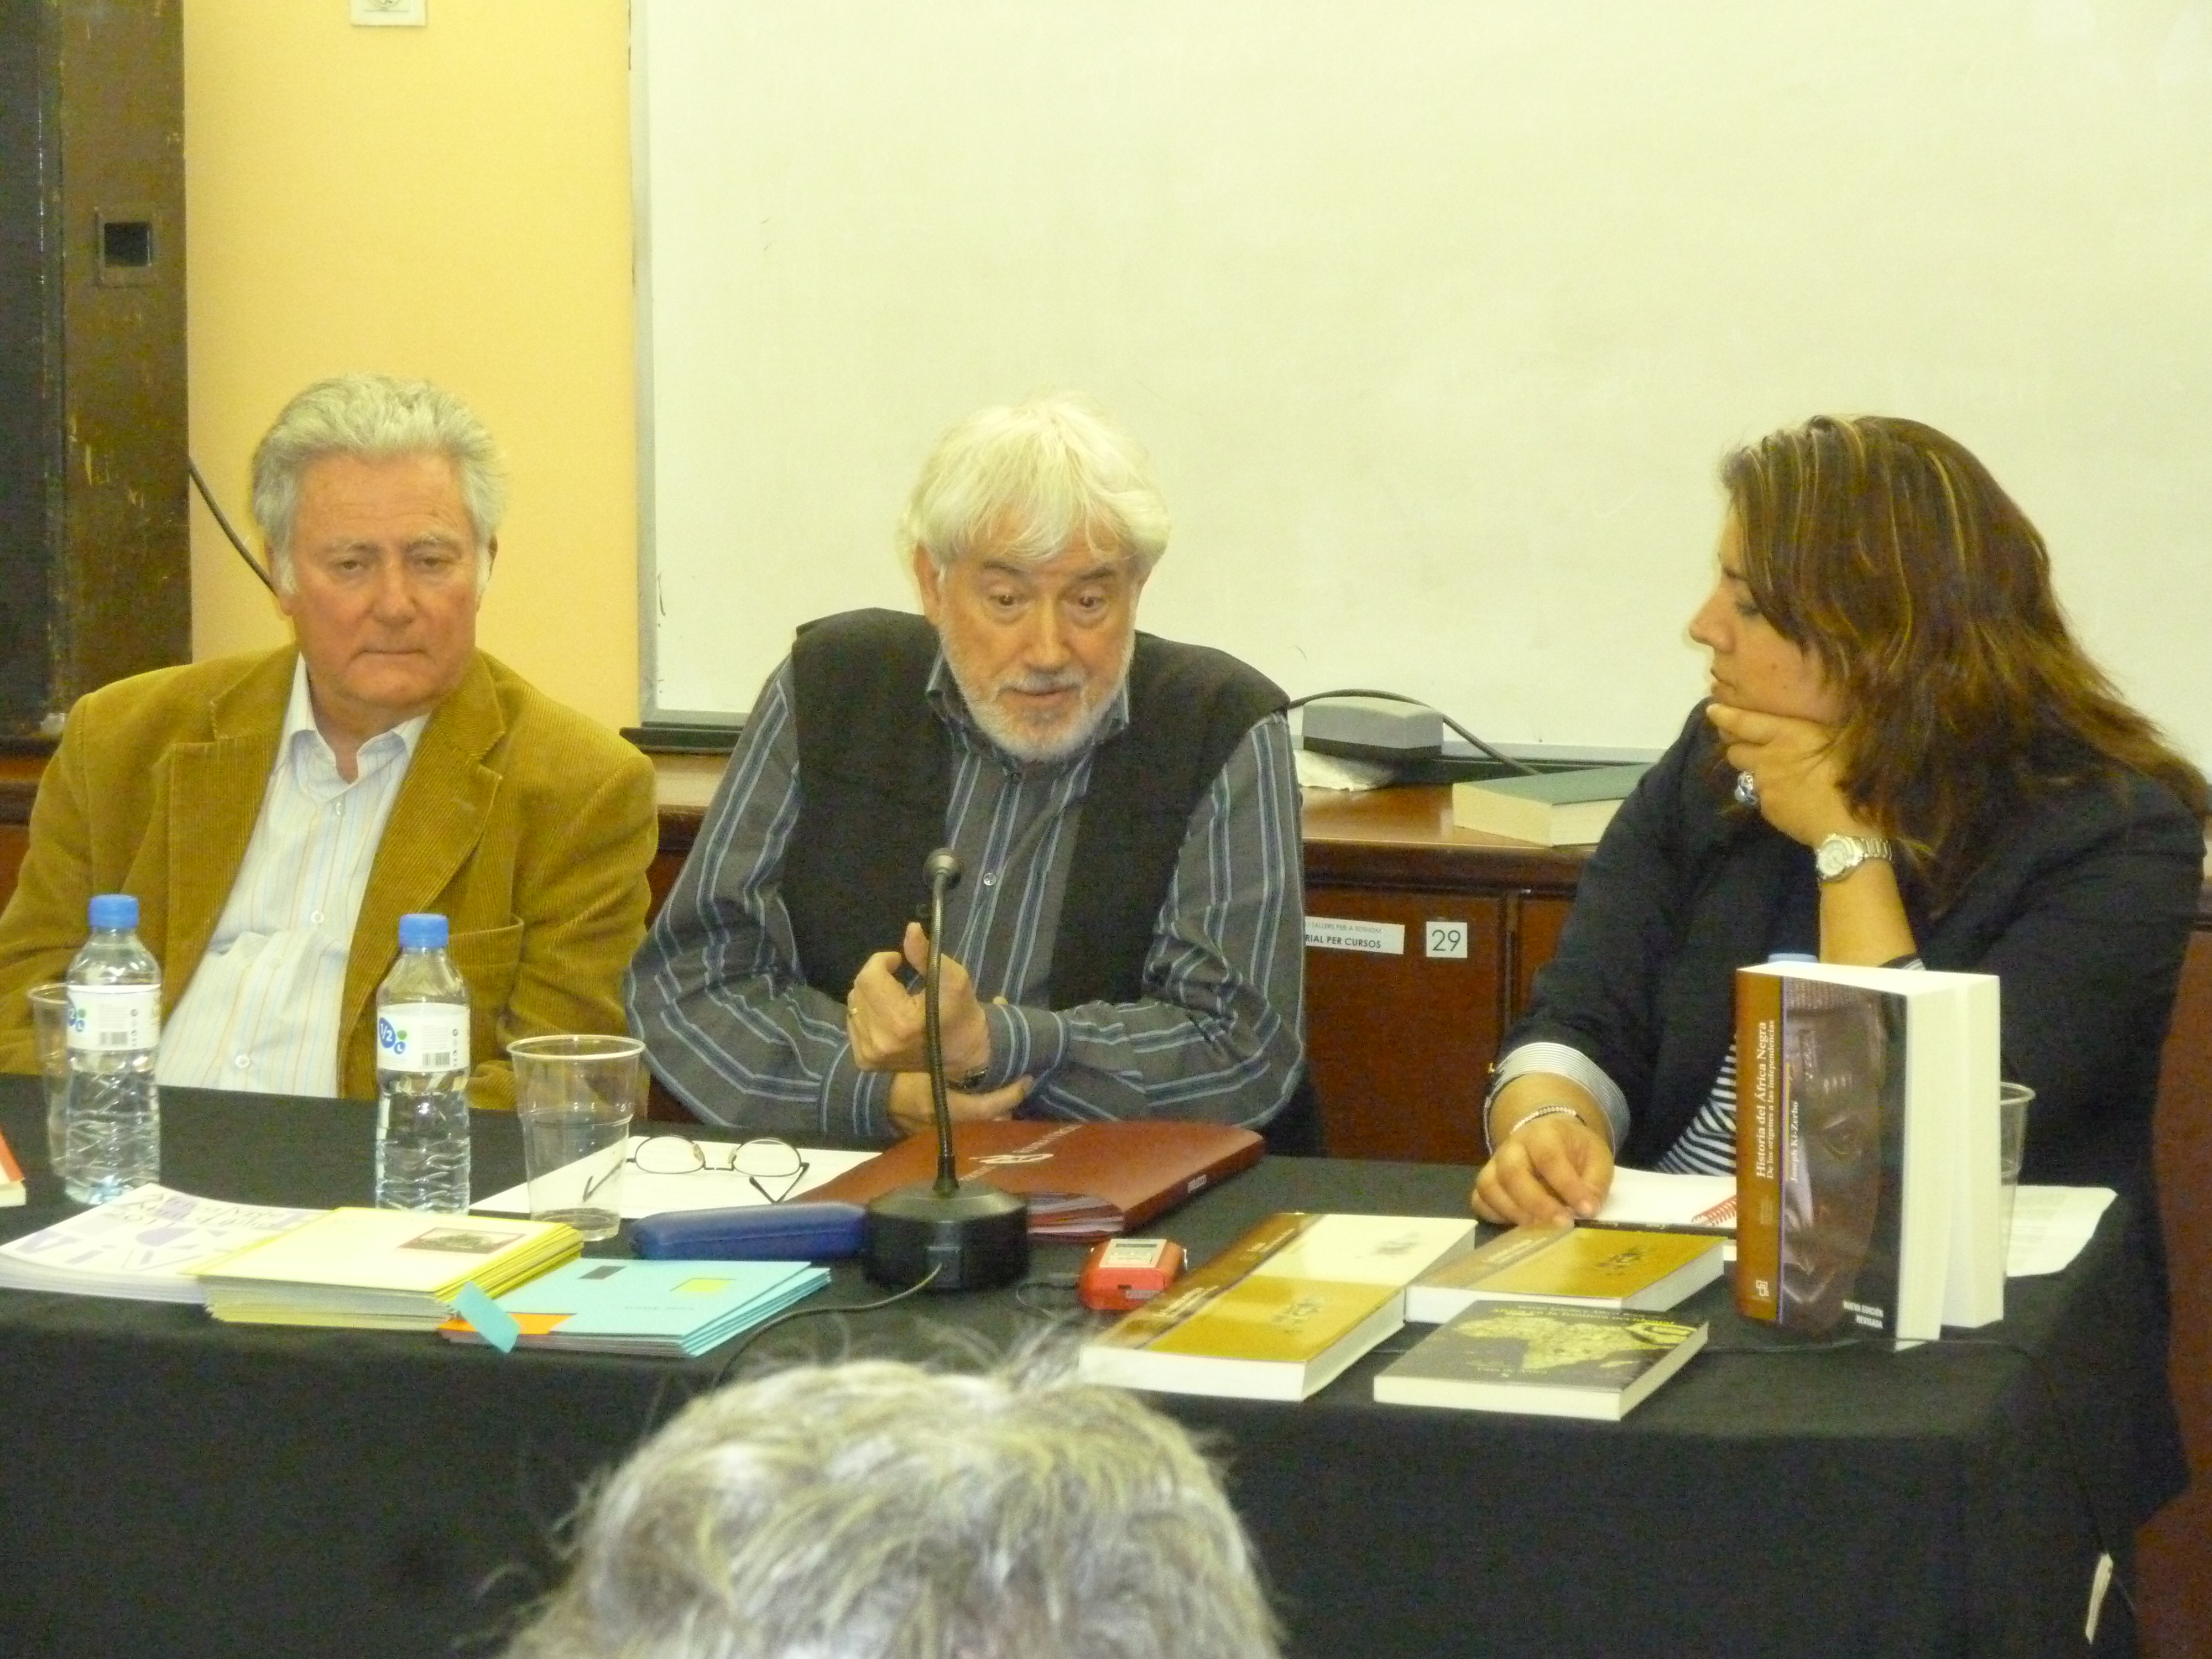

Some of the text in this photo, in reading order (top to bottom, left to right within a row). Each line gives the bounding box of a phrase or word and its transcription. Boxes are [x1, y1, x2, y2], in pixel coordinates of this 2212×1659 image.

[1327, 936, 1342, 945] PER
[1344, 938, 1381, 948] CURSOS
[1432, 930, 1461, 952] 29
[380, 1023, 393, 1042] 1/2
[1767, 1019, 1776, 1089] independencias
[1754, 1021, 1769, 1177] Historia del África Negra
[1790, 1100, 1799, 1182] Joseph Ki-Zerbo
[1766, 1166, 1774, 1179] De
